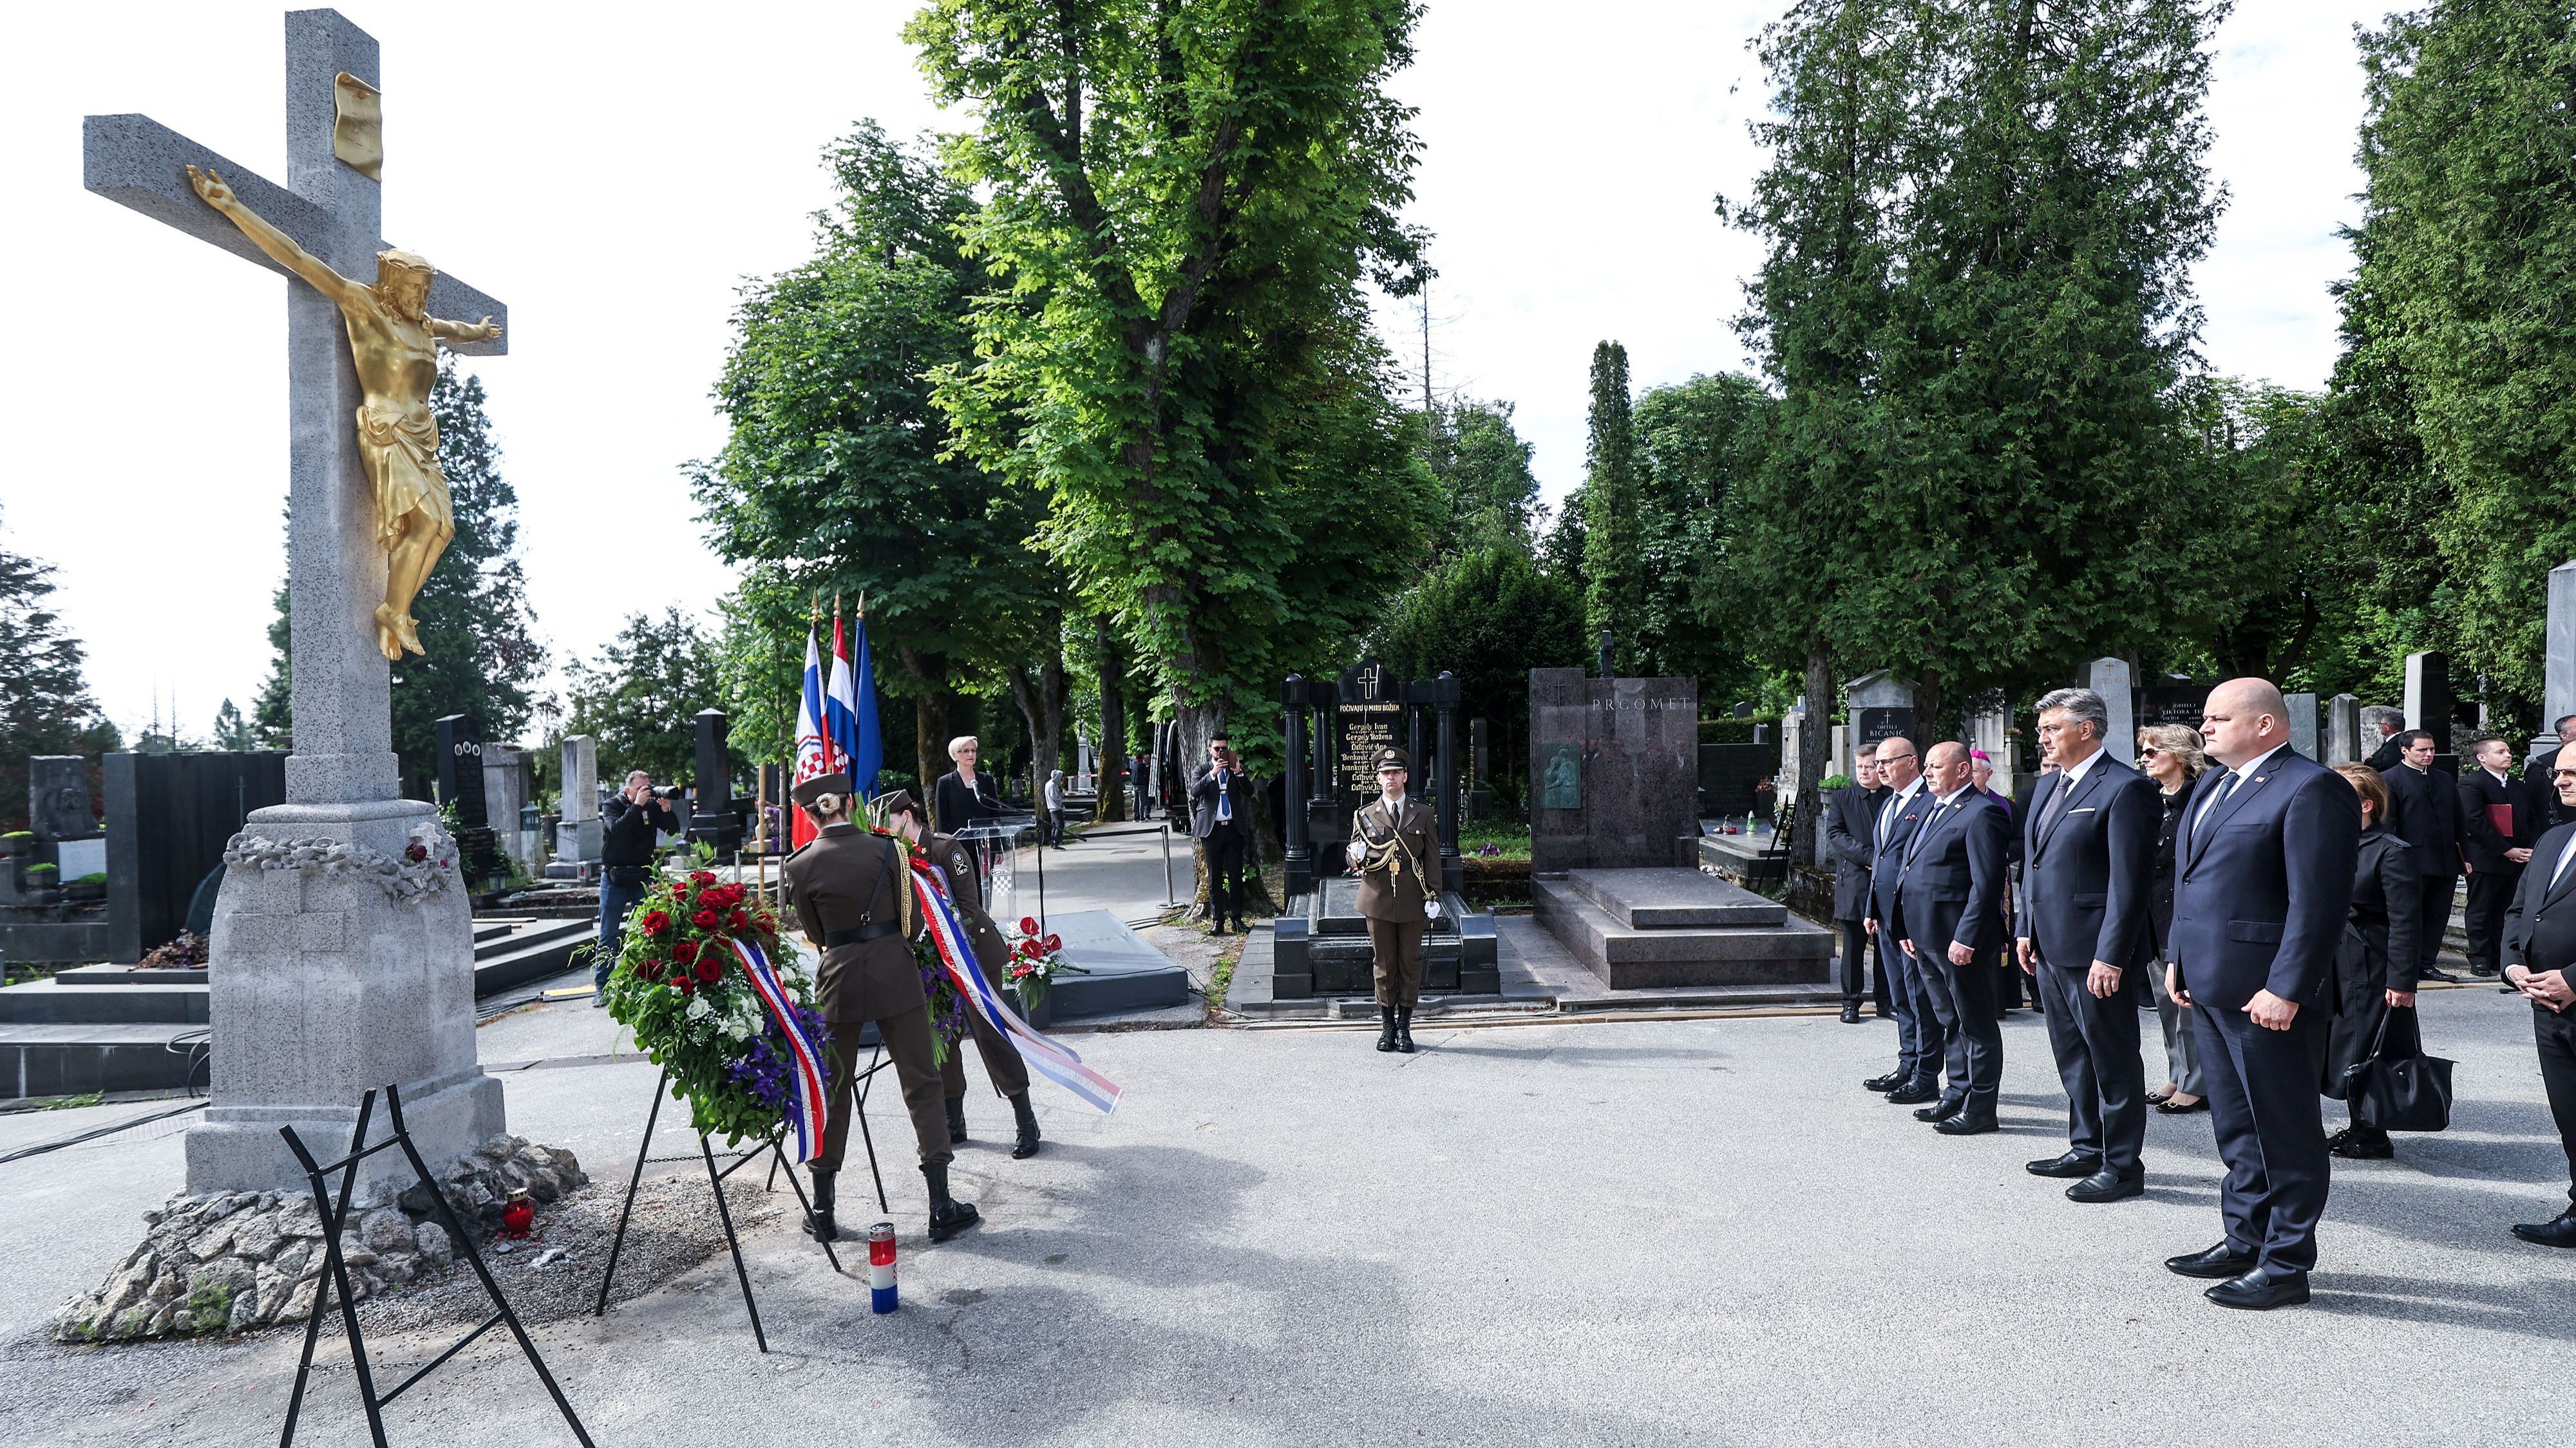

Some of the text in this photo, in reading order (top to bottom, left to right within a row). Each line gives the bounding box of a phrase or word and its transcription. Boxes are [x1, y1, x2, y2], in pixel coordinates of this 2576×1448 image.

[1340, 704, 1363, 712] POČIVAJU
[1383, 703, 1399, 711] BOŽJEM
[1593, 697, 1690, 711] PRGOMET
